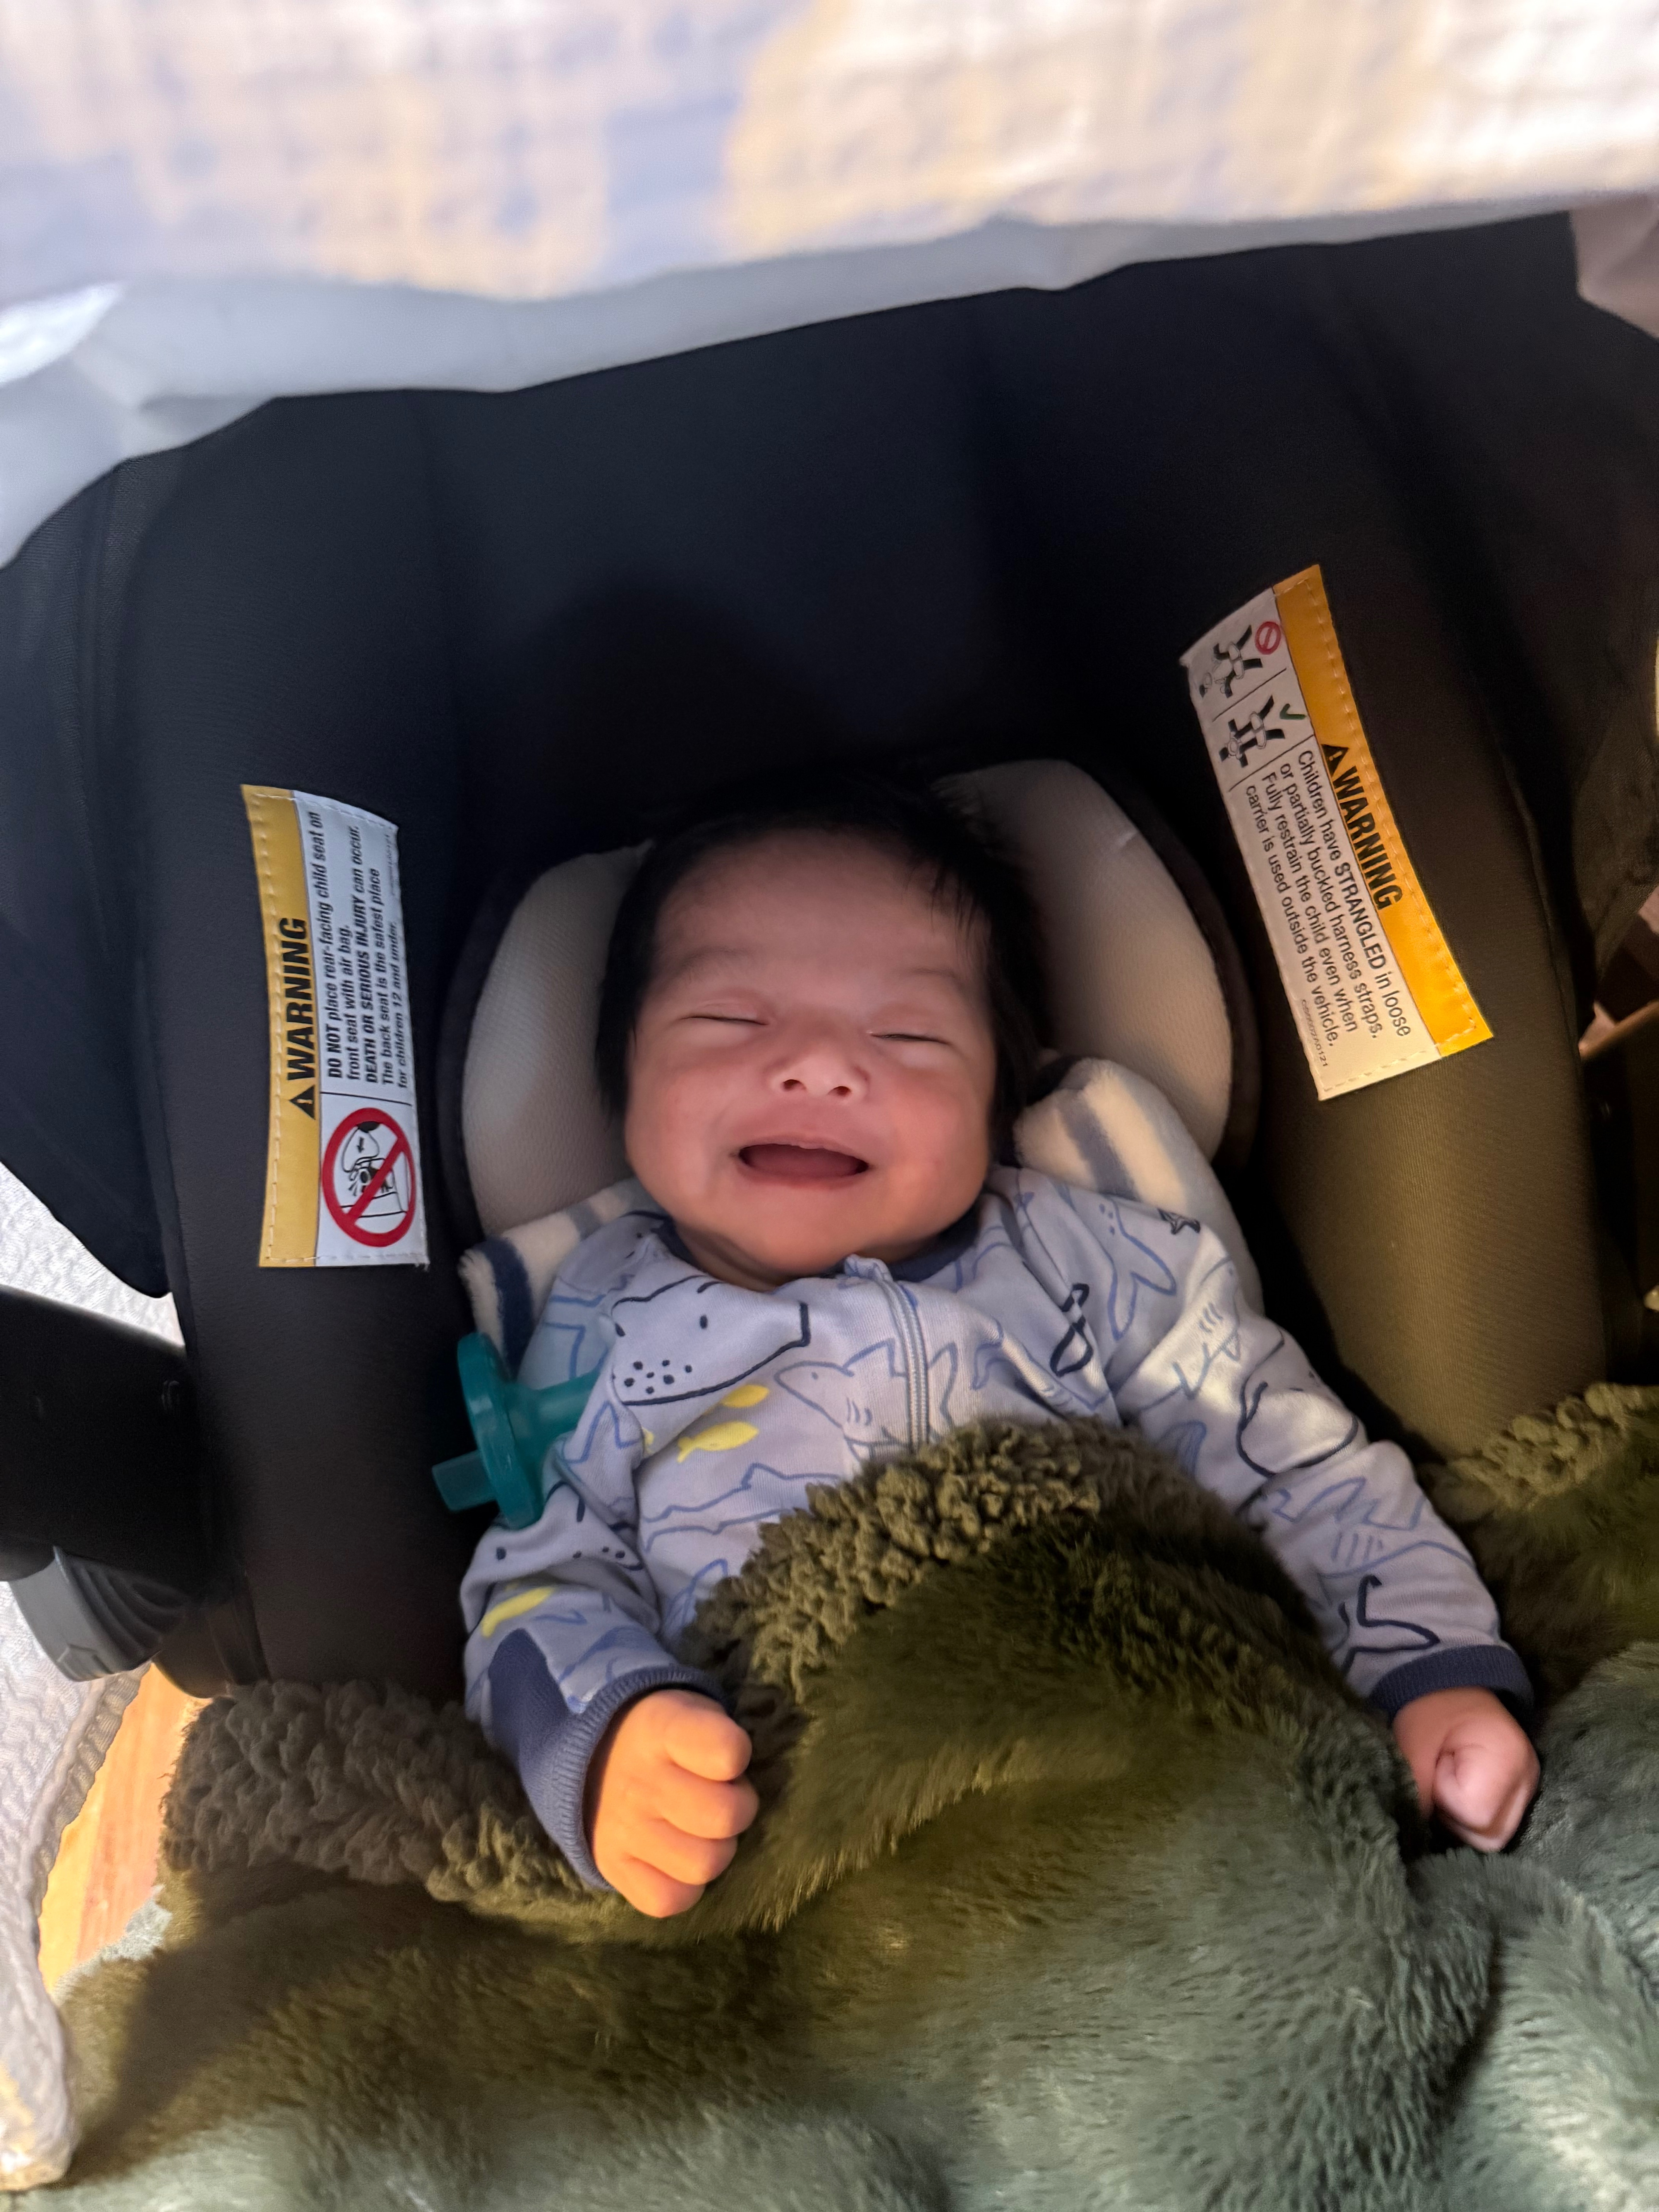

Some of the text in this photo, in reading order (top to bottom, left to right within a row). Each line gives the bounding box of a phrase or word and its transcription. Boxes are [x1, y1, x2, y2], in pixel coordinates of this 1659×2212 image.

[309, 812, 323, 828] on
[309, 831, 325, 861] seat
[1333, 765, 1403, 910] WARNING
[311, 863, 328, 898] child
[1262, 772, 1358, 1032] Fully restrain the child even when
[1280, 763, 1382, 1038] or partially buckled harness straps.
[1298, 750, 1411, 1037] Children have STRANGLED in loose
[1246, 785, 1339, 1046] carrier is used outside the vehicle.
[349, 826, 378, 1083] DEATH OR SERIOUS INJURY can occur.
[369, 868, 394, 1084] The back seat is the safest place
[390, 963, 402, 989] and
[279, 918, 315, 1081] WARNING
[325, 983, 343, 1021] place
[338, 925, 360, 1080] front seat with air bag.
[392, 993, 402, 1007] 12
[326, 1024, 341, 1053] NOT
[394, 1012, 406, 1066] children
[327, 1058, 342, 1078] DO
[397, 1070, 408, 1089] for
